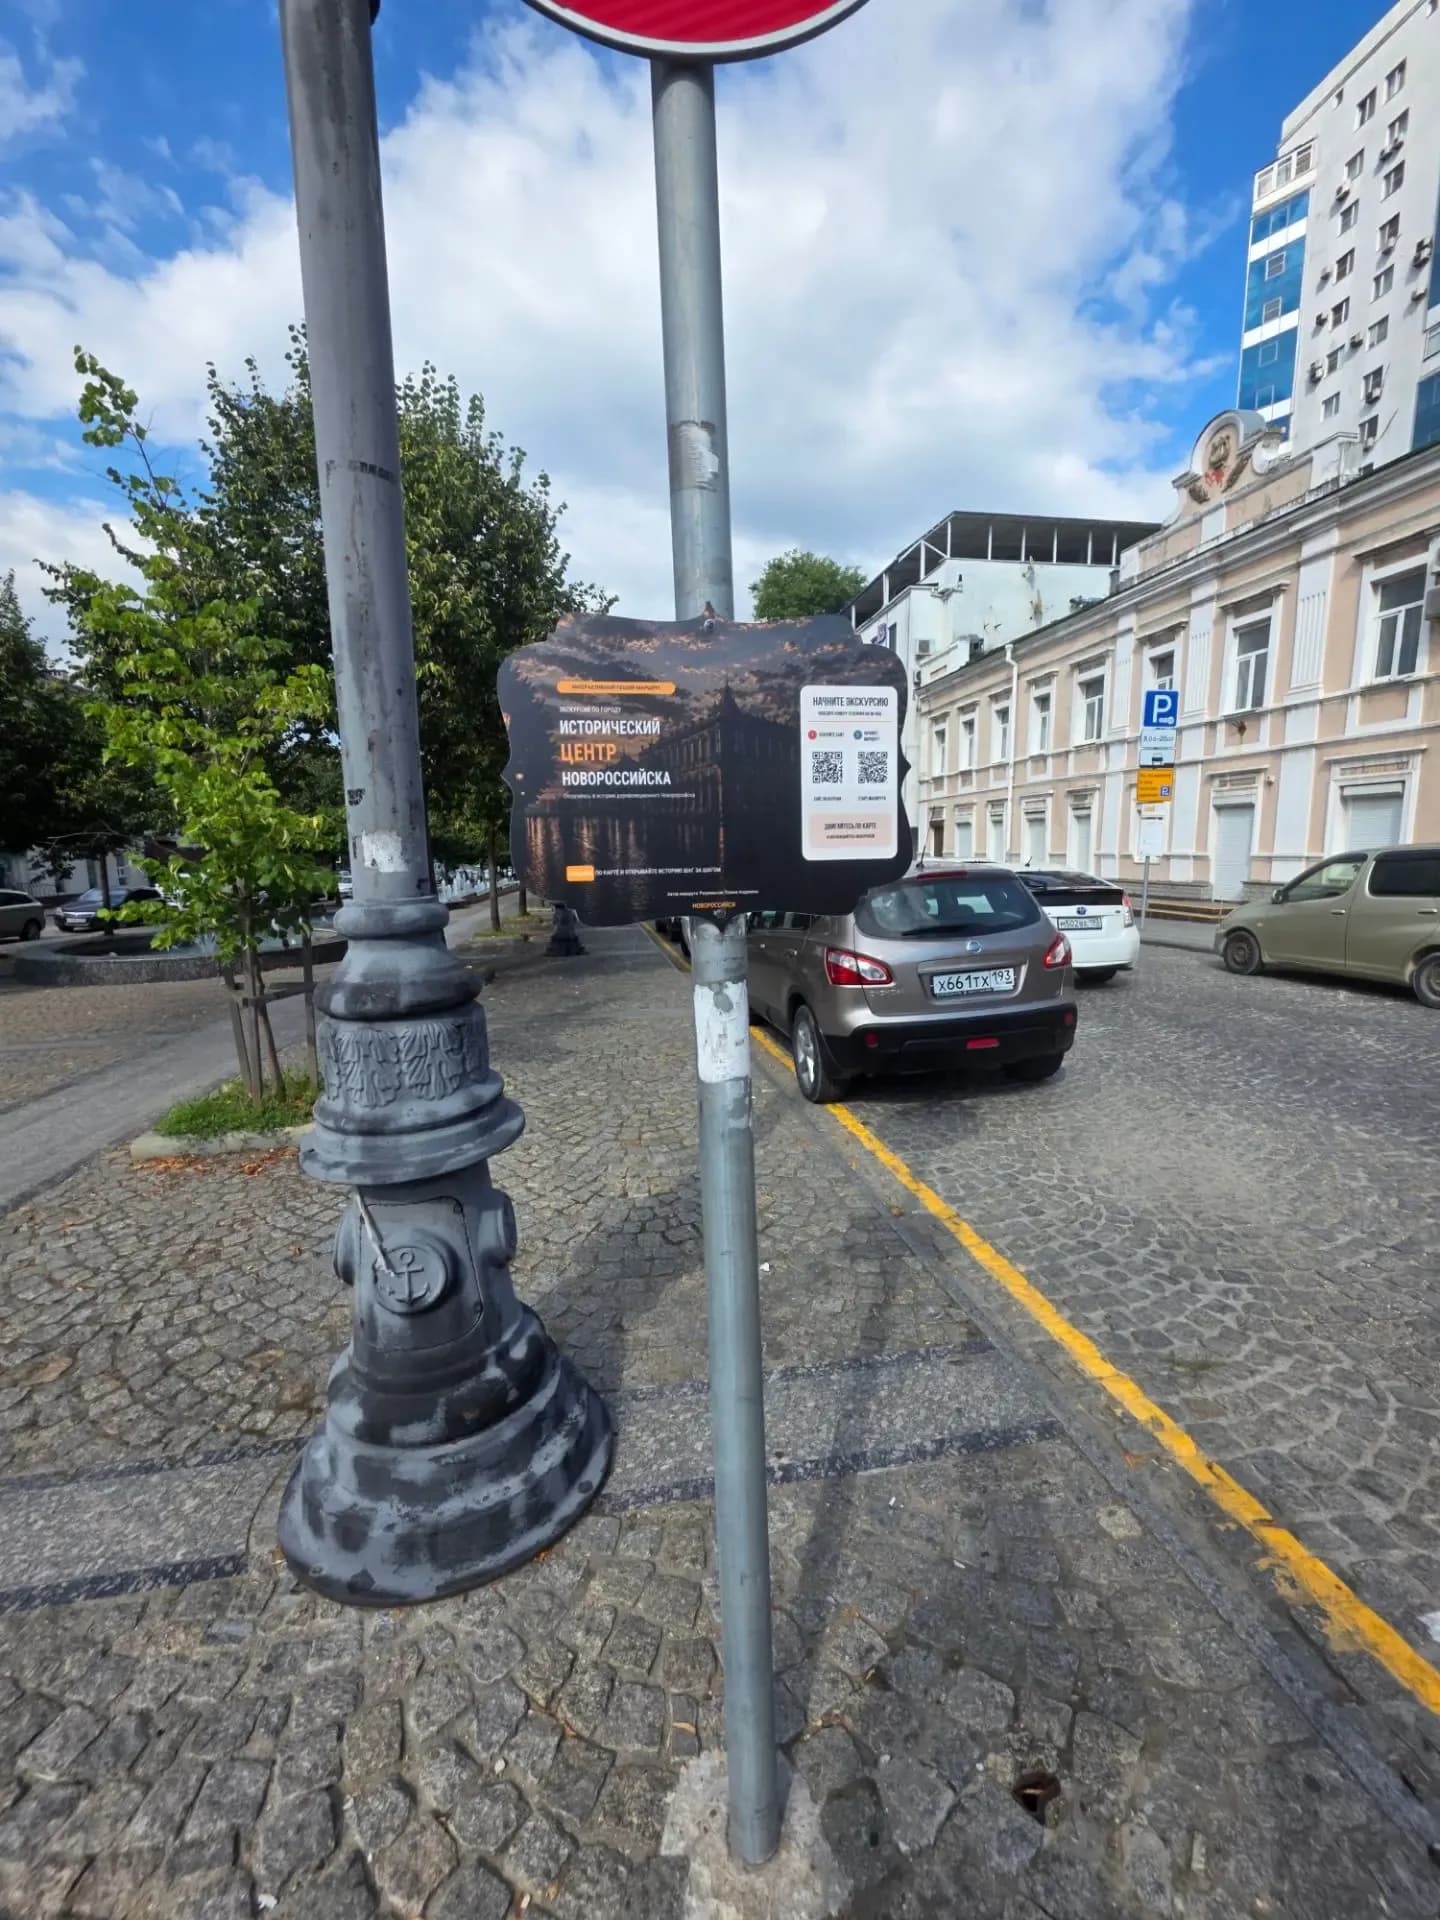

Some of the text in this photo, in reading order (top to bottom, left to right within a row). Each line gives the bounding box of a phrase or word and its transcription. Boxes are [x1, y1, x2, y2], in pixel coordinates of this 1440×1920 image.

[812, 697, 889, 708] НАЧНИТЕ ЭКСКУРСИЮ
[559, 717, 661, 735] ИСТОРИЧЕСКИЙ
[560, 743, 617, 765] ЦЕНТР
[562, 768, 672, 786] НОВОРОССИЙСКА
[938, 969, 1012, 992] Х661ТХ 193
